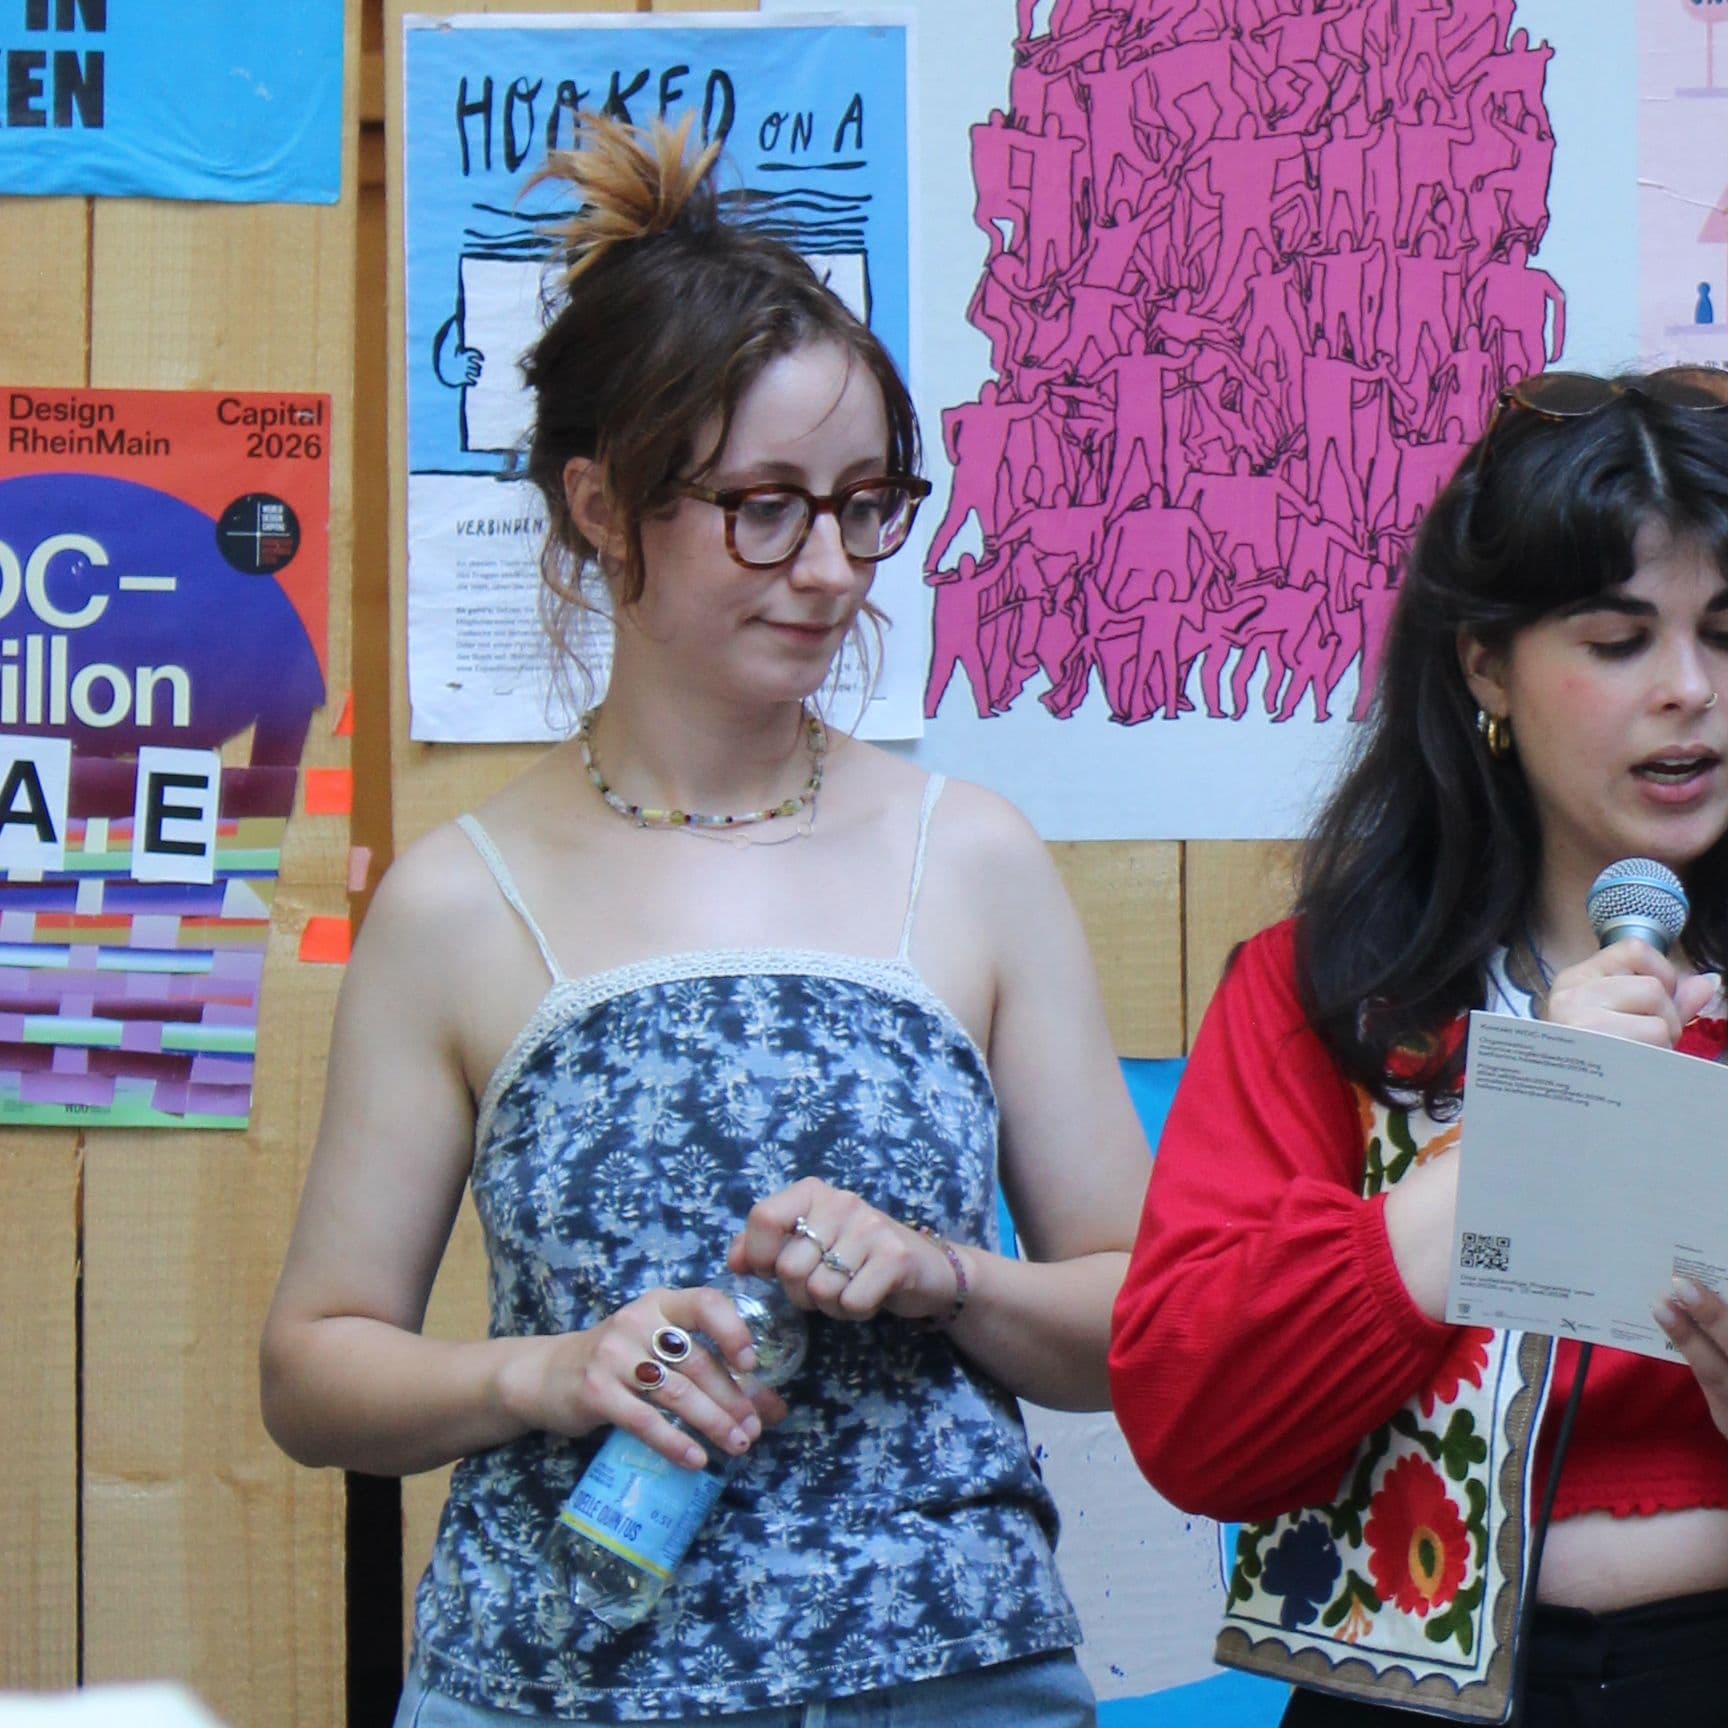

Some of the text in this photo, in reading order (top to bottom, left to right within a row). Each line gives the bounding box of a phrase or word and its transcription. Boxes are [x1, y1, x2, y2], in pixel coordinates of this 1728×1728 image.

[758, 110, 813, 154] ON
[833, 92, 863, 153] A
[9, 394, 323, 430] Design Capital
[8, 427, 322, 460] RheinMain 2026
